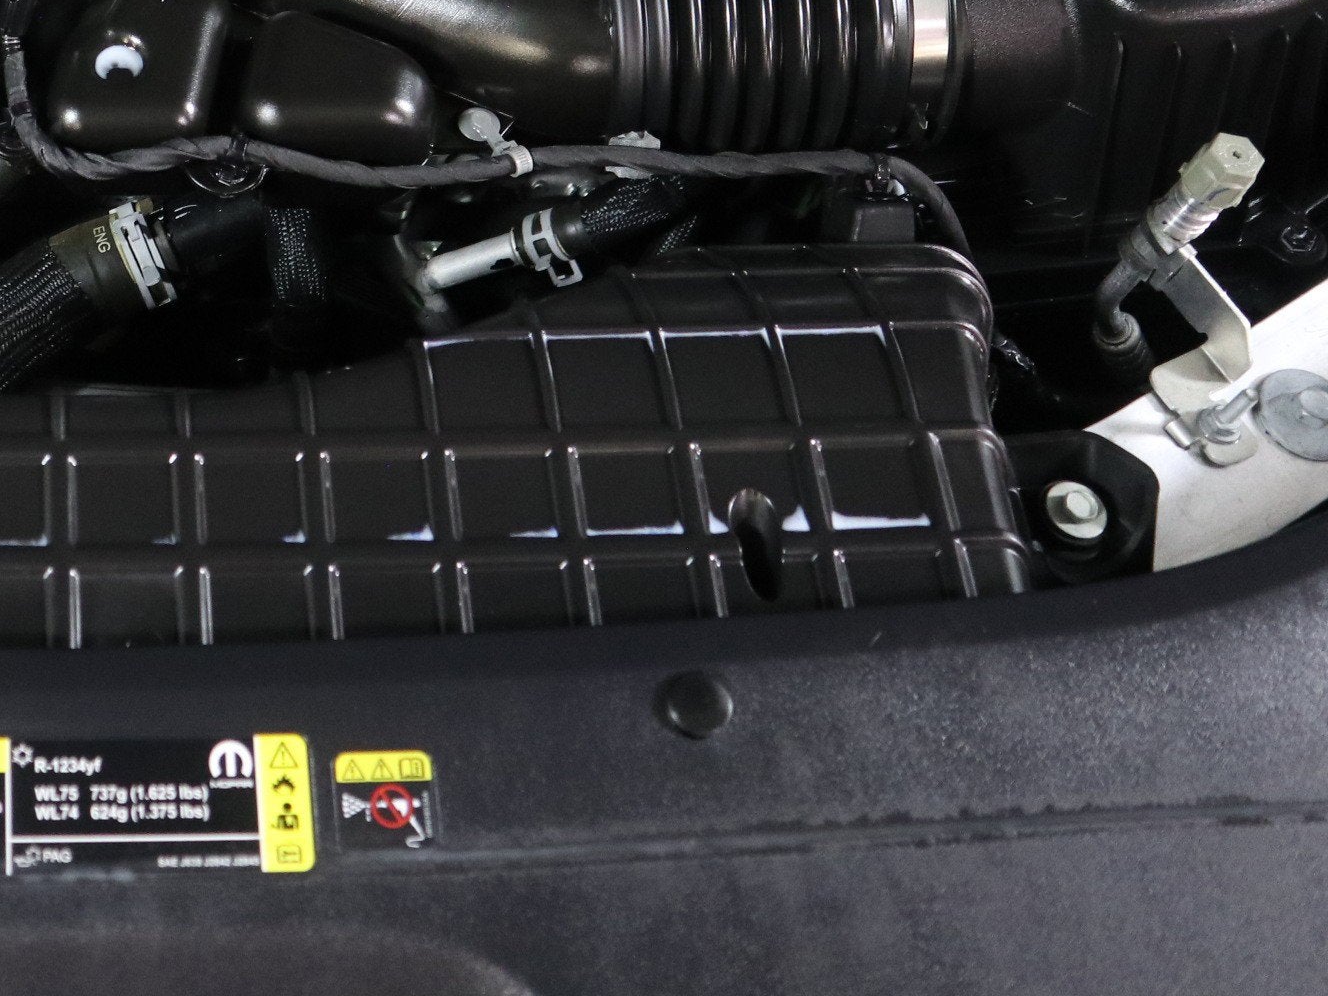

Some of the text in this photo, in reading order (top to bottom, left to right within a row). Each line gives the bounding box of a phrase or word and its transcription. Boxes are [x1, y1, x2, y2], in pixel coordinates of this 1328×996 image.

[92, 225, 111, 254] ENG
[33, 756, 102, 777] R-1234yf
[34, 783, 209, 804] WL75 737g (1.625 lbs)
[34, 802, 210, 823] WL74 624g (1.375 lbs)
[42, 847, 72, 864] PAG
